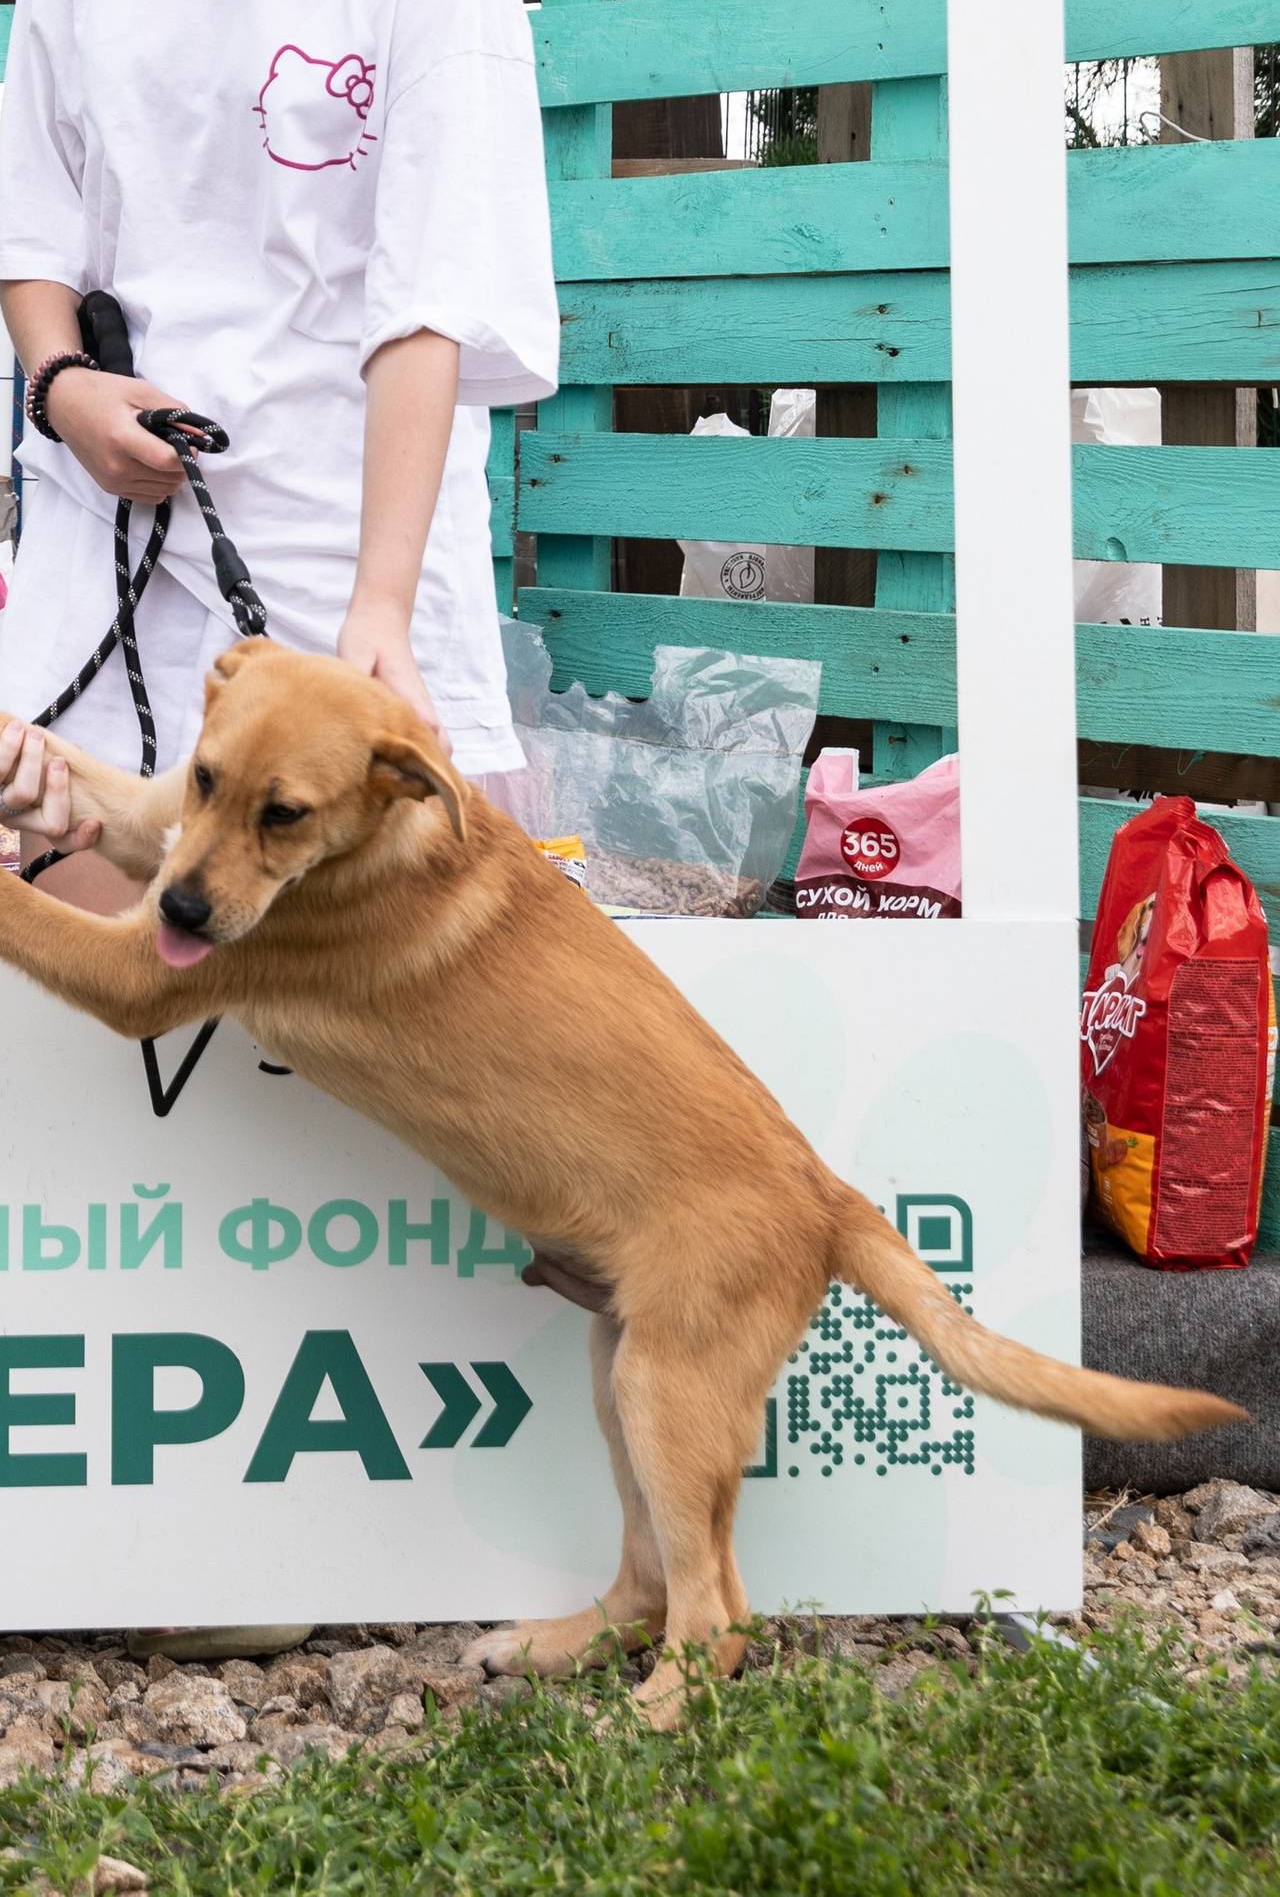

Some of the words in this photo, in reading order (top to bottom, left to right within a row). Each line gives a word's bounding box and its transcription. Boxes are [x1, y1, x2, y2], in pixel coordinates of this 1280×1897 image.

[843, 830, 897, 858] 365
[854, 861, 884, 872] дней
[796, 885, 870, 911] СУХОЙ
[877, 895, 942, 919] КОРМ
[218, 1197, 532, 1279] ФОНД
